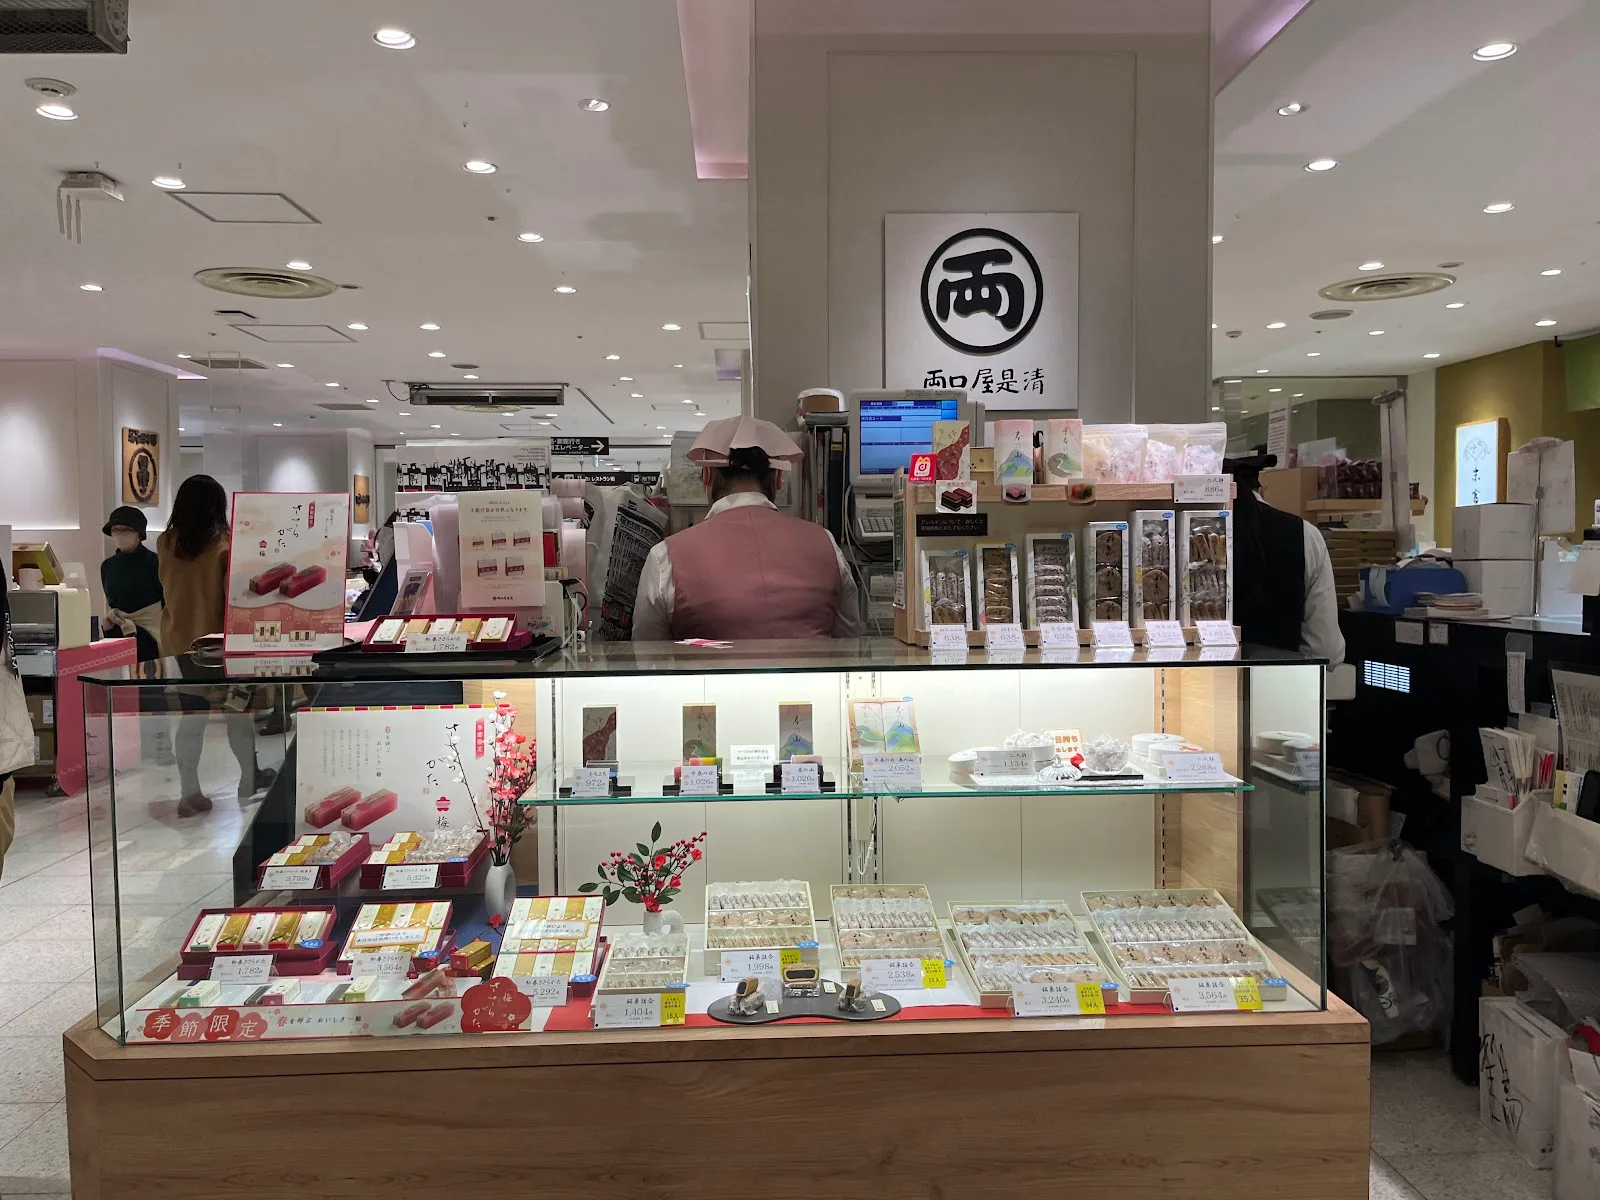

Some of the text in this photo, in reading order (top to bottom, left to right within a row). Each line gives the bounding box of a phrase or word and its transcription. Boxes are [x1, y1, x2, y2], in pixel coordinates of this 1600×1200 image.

[936, 248, 1025, 331] 両
[923, 367, 1045, 394] 両口屋是清
[888, 764, 915, 772] 2,052円
[1190, 763, 1217, 771] 2,268円
[585, 779, 606, 787] 972円
[238, 966, 264, 975] 1,782円
[376, 963, 403, 972] 3,564円
[747, 963, 774, 971] 1,998円
[887, 970, 915, 979] 2,538円
[533, 988, 560, 996] 5,292円
[1198, 991, 1228, 1000] 3,564円
[1041, 995, 1070, 1004] 3,240円
[1239, 994, 1257, 1003] 35入
[624, 1007, 653, 1017] 1,404円
[151, 1012, 259, 1040] 季節限定
[276, 1015, 362, 1028] 春を呼ぶ おいしさ一輪
